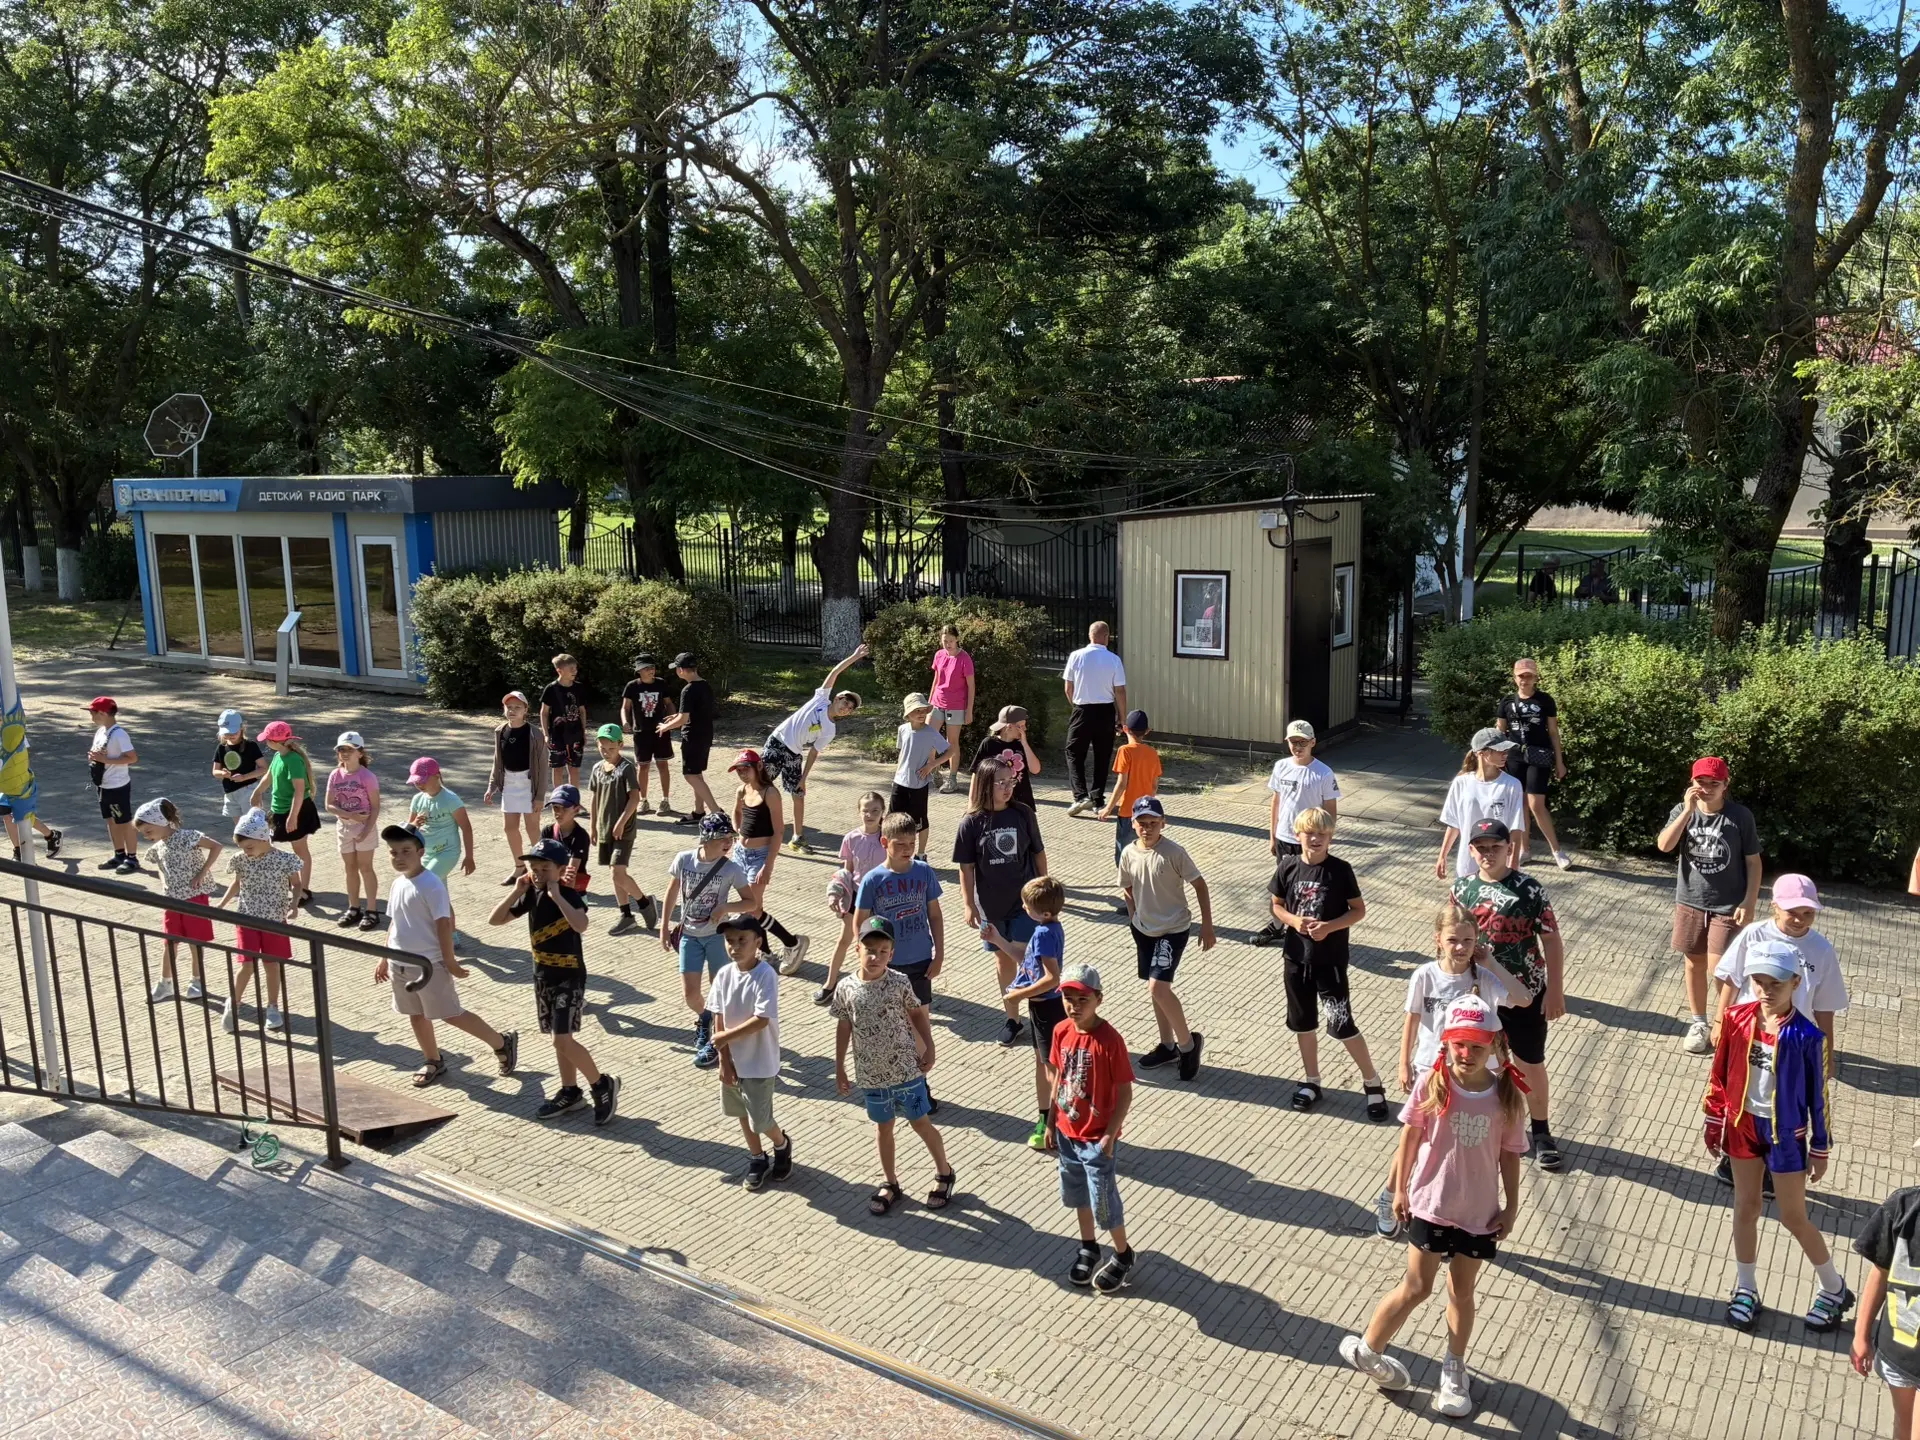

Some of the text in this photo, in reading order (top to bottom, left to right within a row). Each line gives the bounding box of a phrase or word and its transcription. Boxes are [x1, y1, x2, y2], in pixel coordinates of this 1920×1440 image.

[133, 488, 227, 502] КВАНТОРИУМ
[258, 490, 382, 502] ДЕТСКИЙ РАДИО ПАРК
[1450, 1110, 1492, 1124] ENJOY
[1450, 1122, 1489, 1138] YOUR
